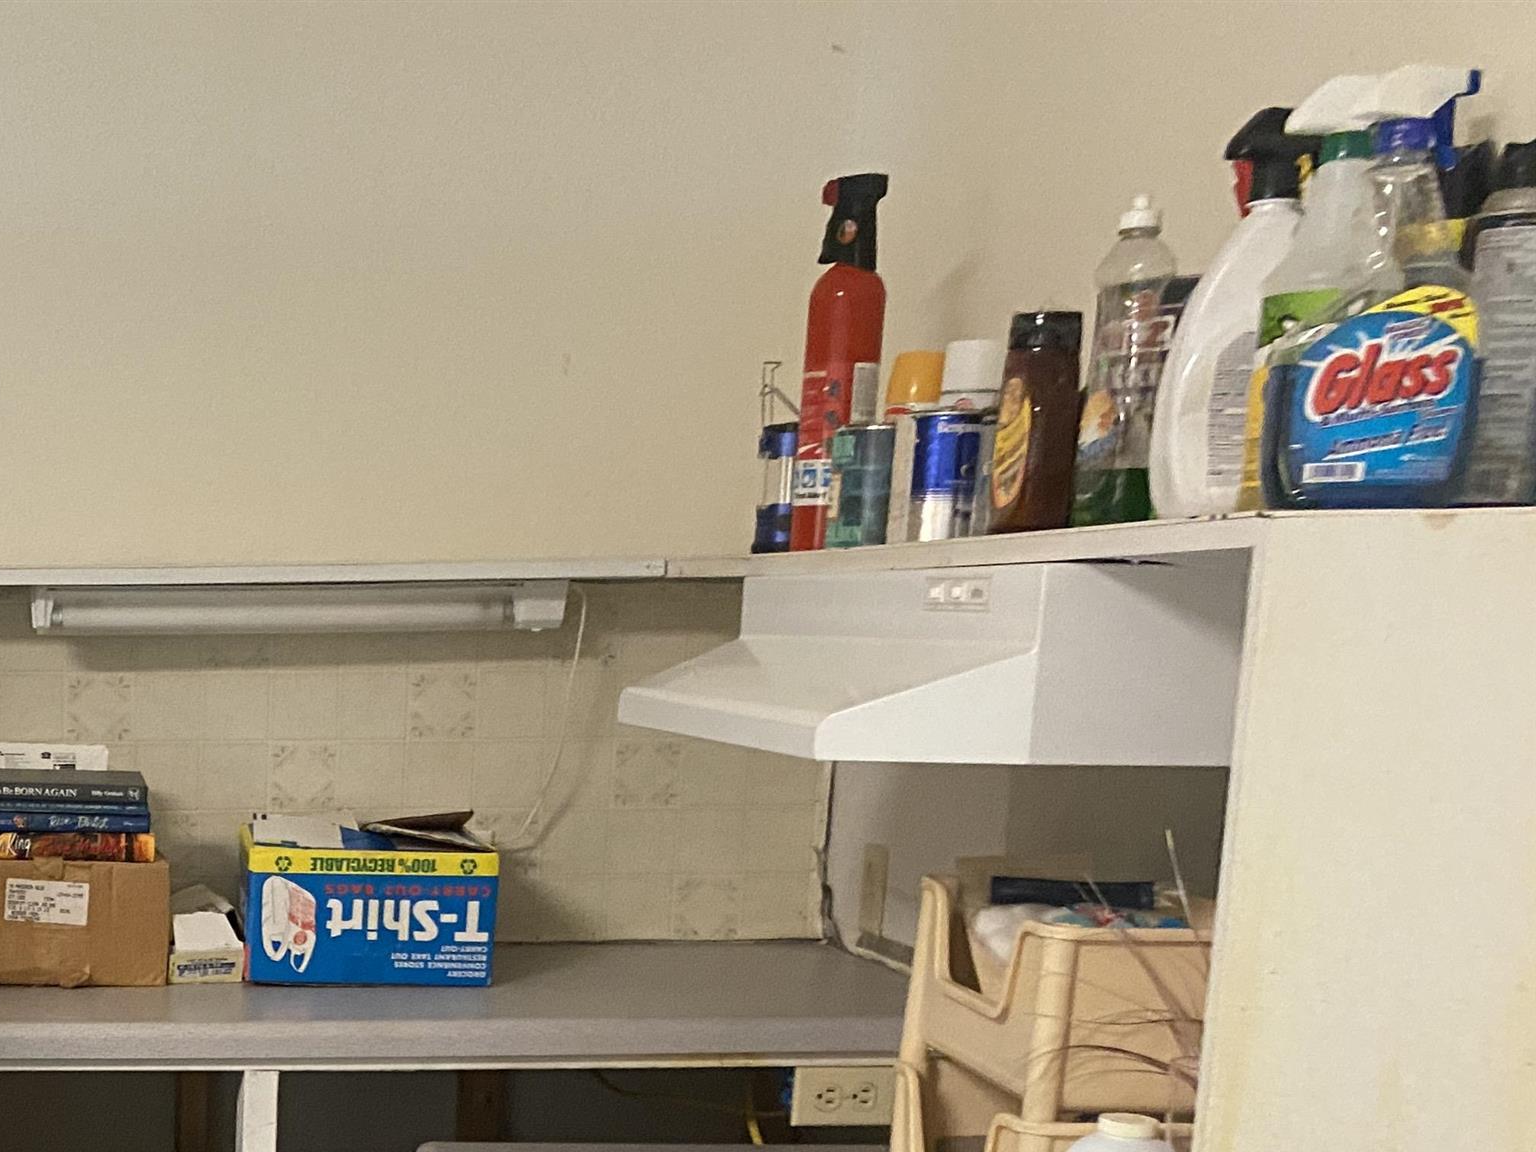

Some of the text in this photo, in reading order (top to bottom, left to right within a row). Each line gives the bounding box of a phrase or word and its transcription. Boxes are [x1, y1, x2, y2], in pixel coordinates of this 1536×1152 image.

[1310, 341, 1462, 417] Glass
[2, 786, 14, 795] Be
[14, 786, 42, 796] BORN
[43, 787, 78, 797] AGAIN
[5, 832, 32, 858] King
[310, 856, 437, 874] 100% RECYCLABLE
[324, 883, 374, 896] BAGS
[326, 898, 489, 942] T-Shirt
[391, 952, 409, 960] OUT
[434, 953, 487, 961] RESTAURANT
[427, 961, 487, 969] CONVENIENCE
[446, 970, 486, 978] GROCERY
